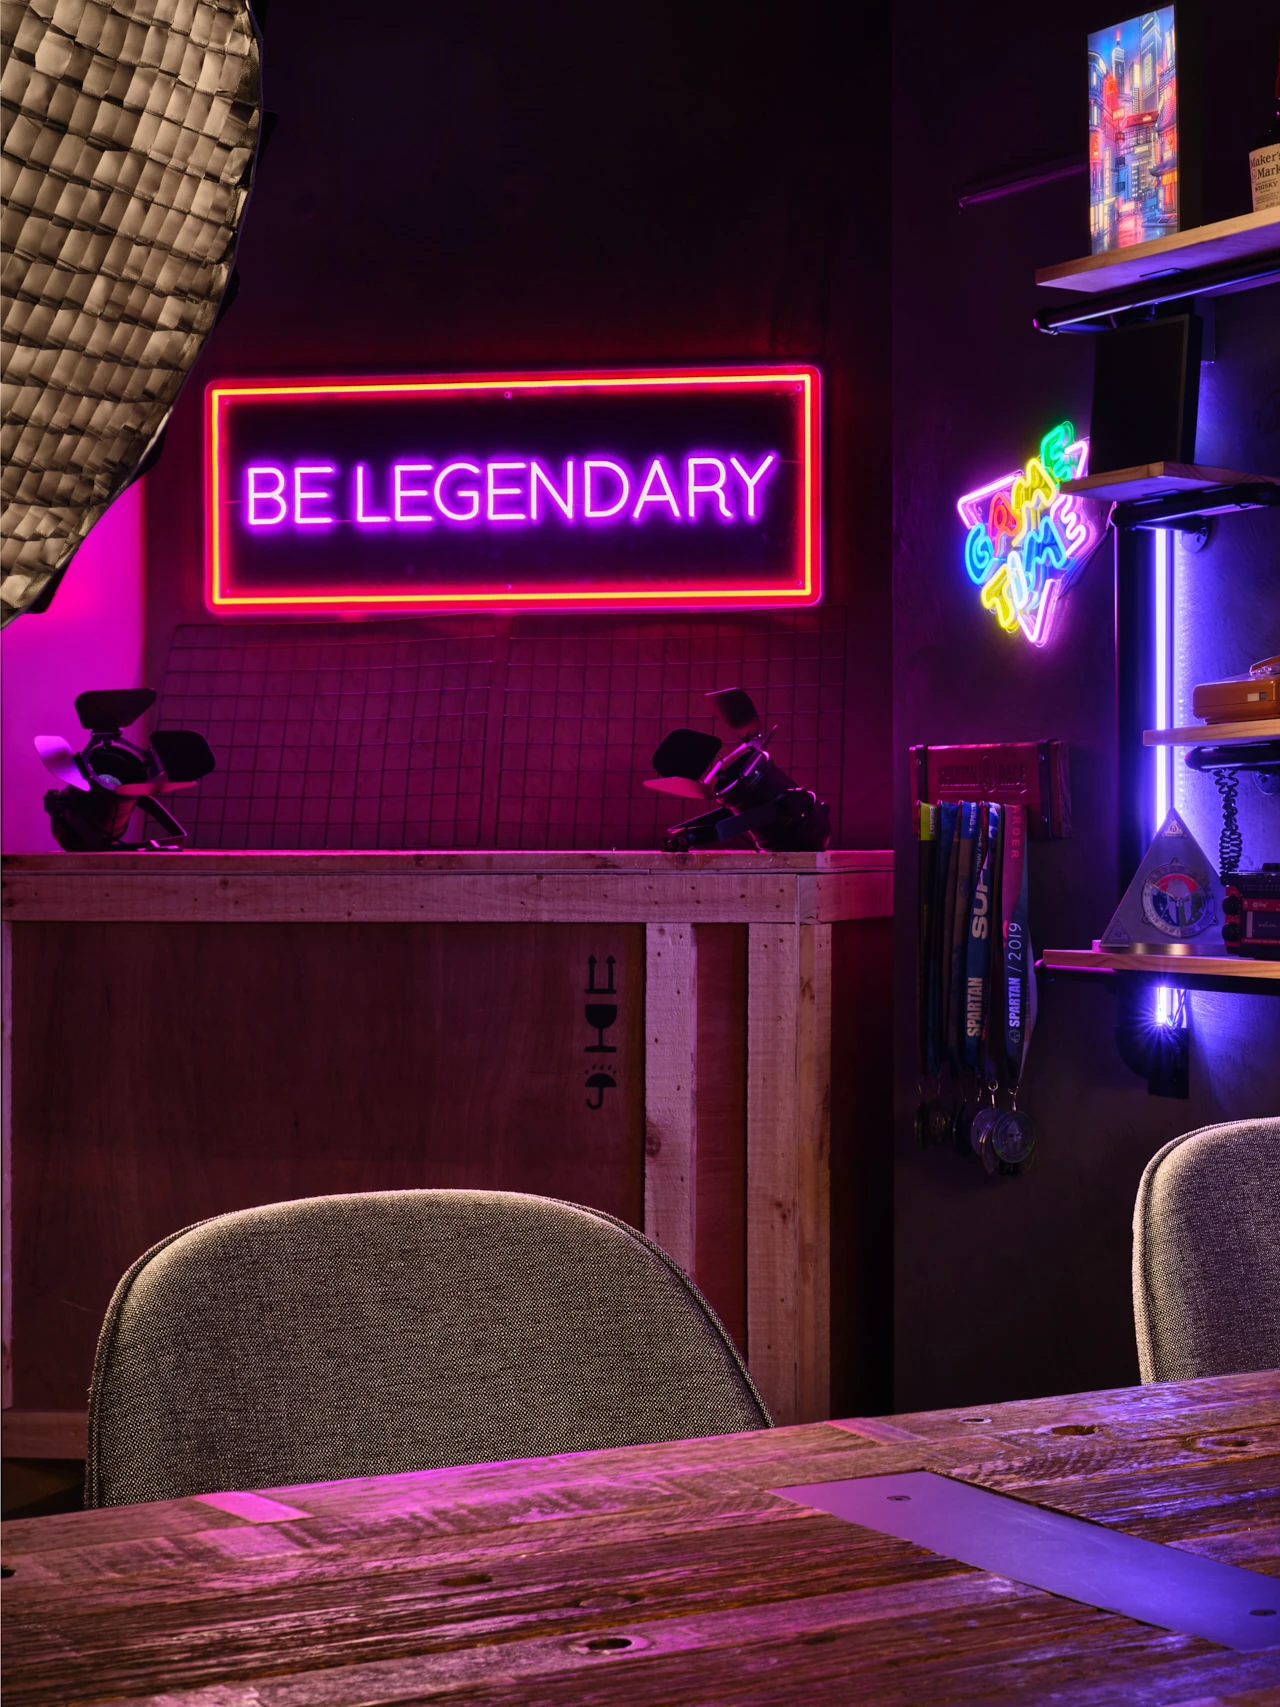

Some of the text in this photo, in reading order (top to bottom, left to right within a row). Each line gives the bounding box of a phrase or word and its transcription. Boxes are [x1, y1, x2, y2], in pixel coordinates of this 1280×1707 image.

[246, 453, 776, 526] BE LEGENDARY
[1010, 805, 1022, 859] ARDER
[1008, 922, 1022, 961] 2019
[966, 977, 983, 1037] SPARTAN
[1008, 977, 1021, 1028] SPARTAN
